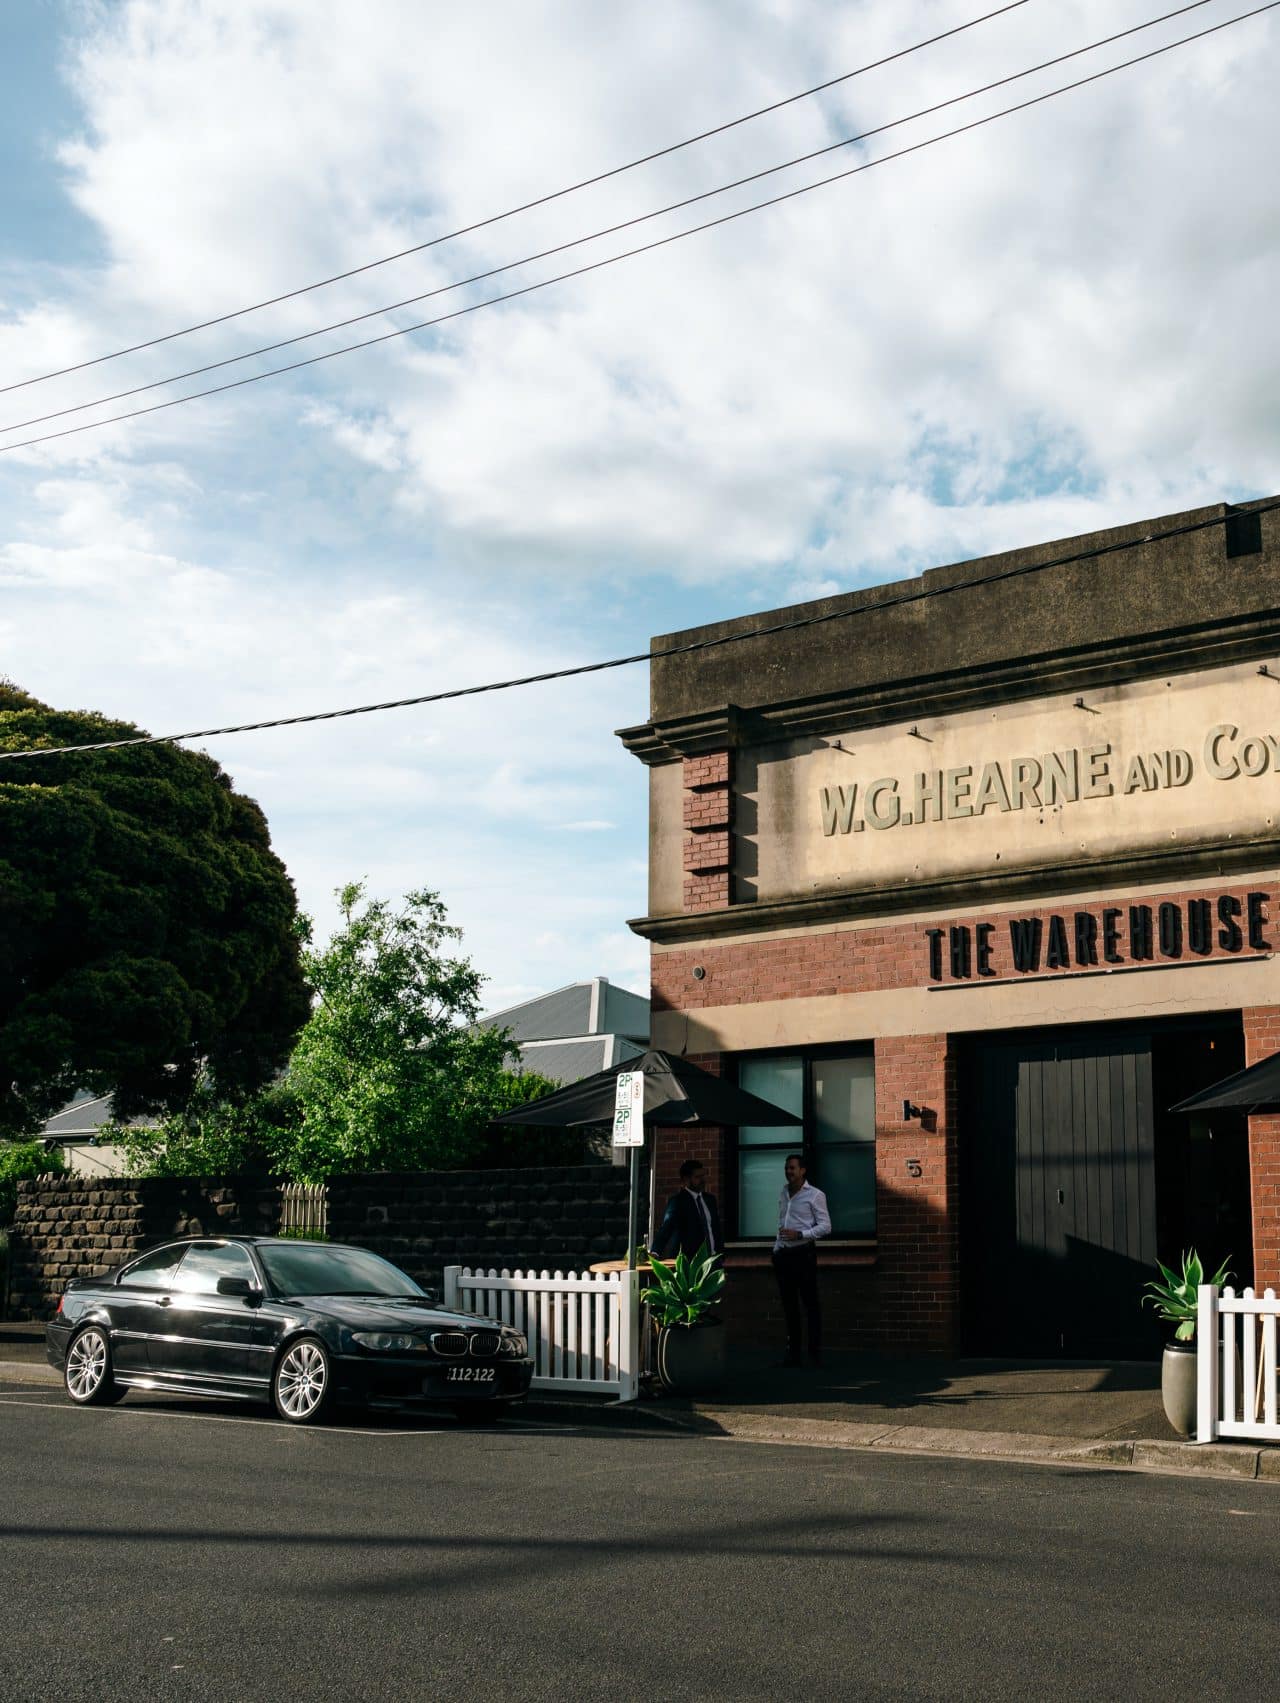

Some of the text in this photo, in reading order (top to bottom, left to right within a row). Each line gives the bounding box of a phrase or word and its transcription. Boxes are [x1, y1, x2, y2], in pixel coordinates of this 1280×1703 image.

[1124, 750, 1193, 794] AND
[925, 892, 1273, 981] THE WAREHOUSE
[618, 1074, 631, 1087] 2P
[616, 1110, 630, 1124] 2P
[905, 1159, 922, 1178] 5
